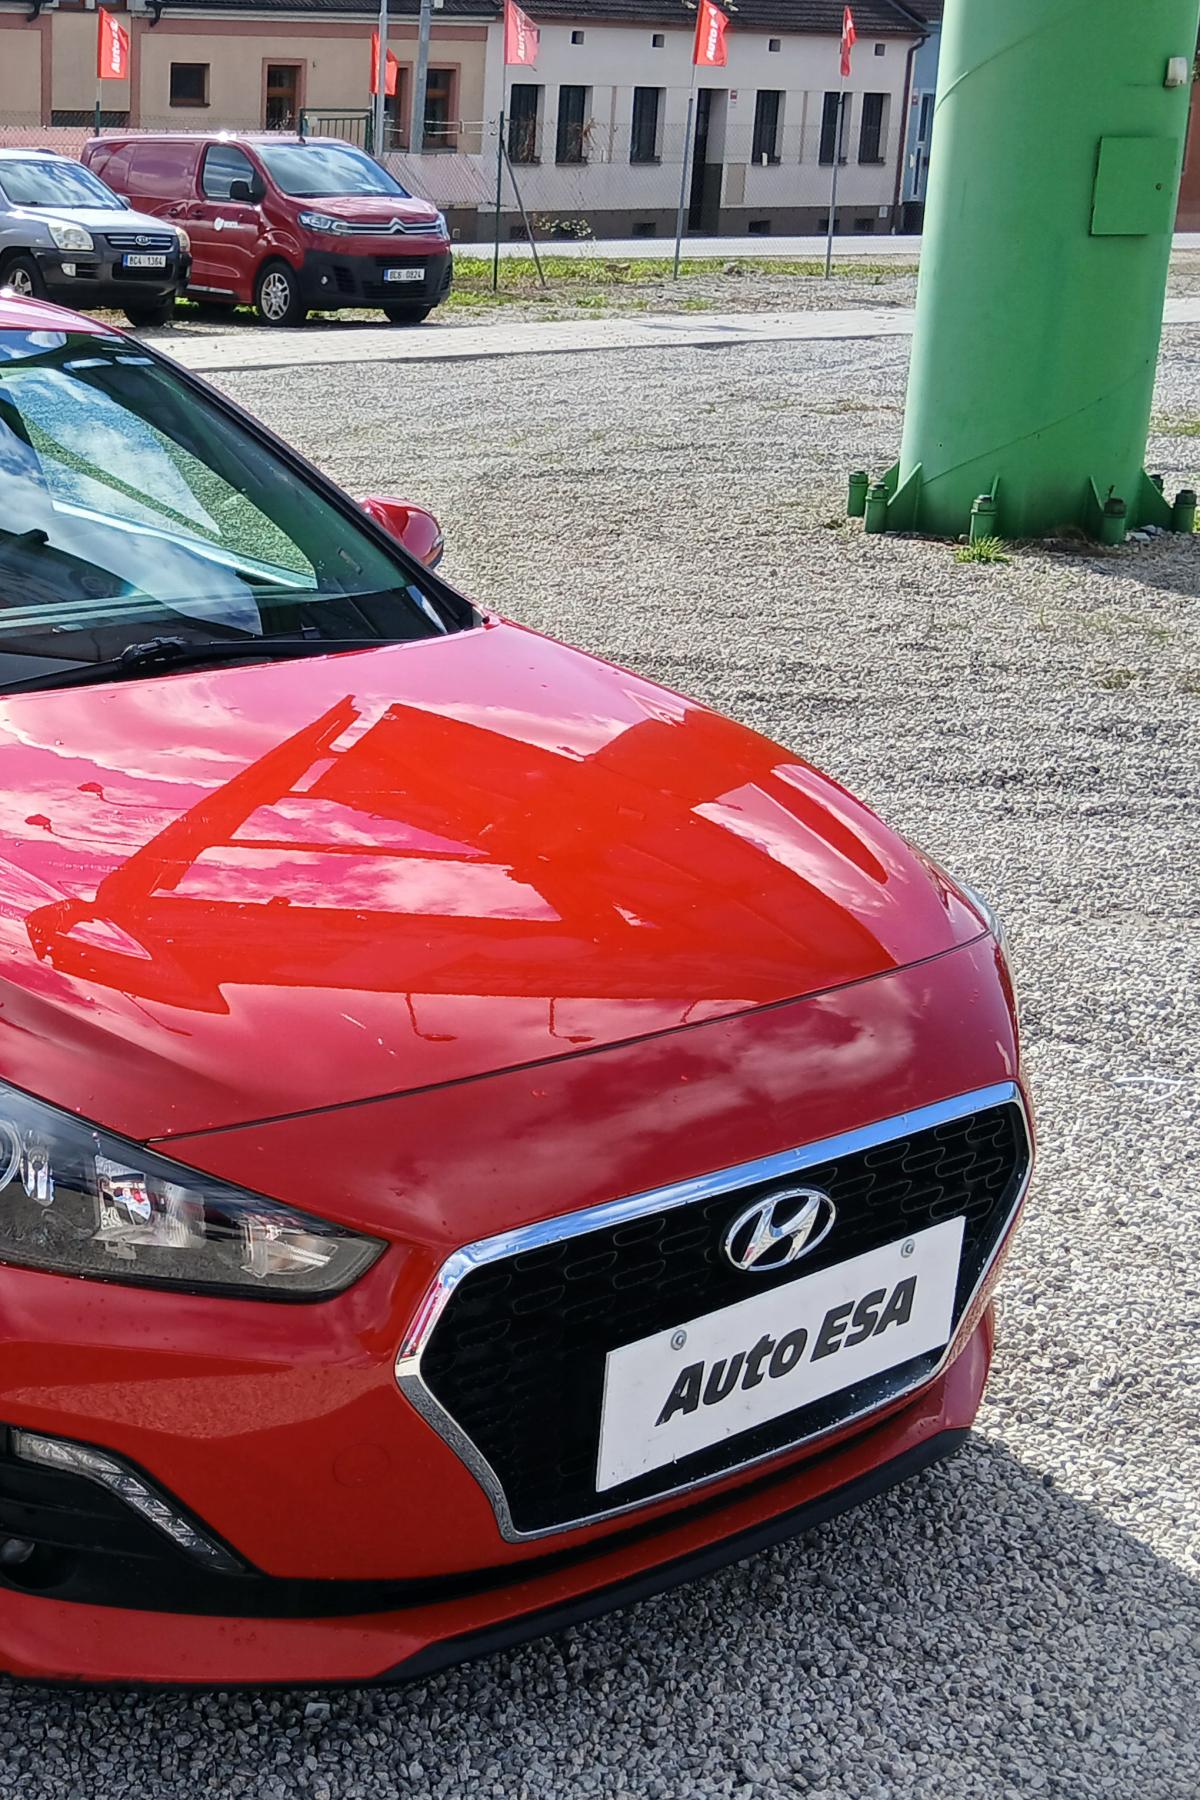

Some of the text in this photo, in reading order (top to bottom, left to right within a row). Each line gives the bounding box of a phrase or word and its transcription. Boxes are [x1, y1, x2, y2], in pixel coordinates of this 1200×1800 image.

[111, 39, 121, 74] Auto
[706, 28, 718, 61] Auto
[654, 1275, 918, 1427] Auto ESA
